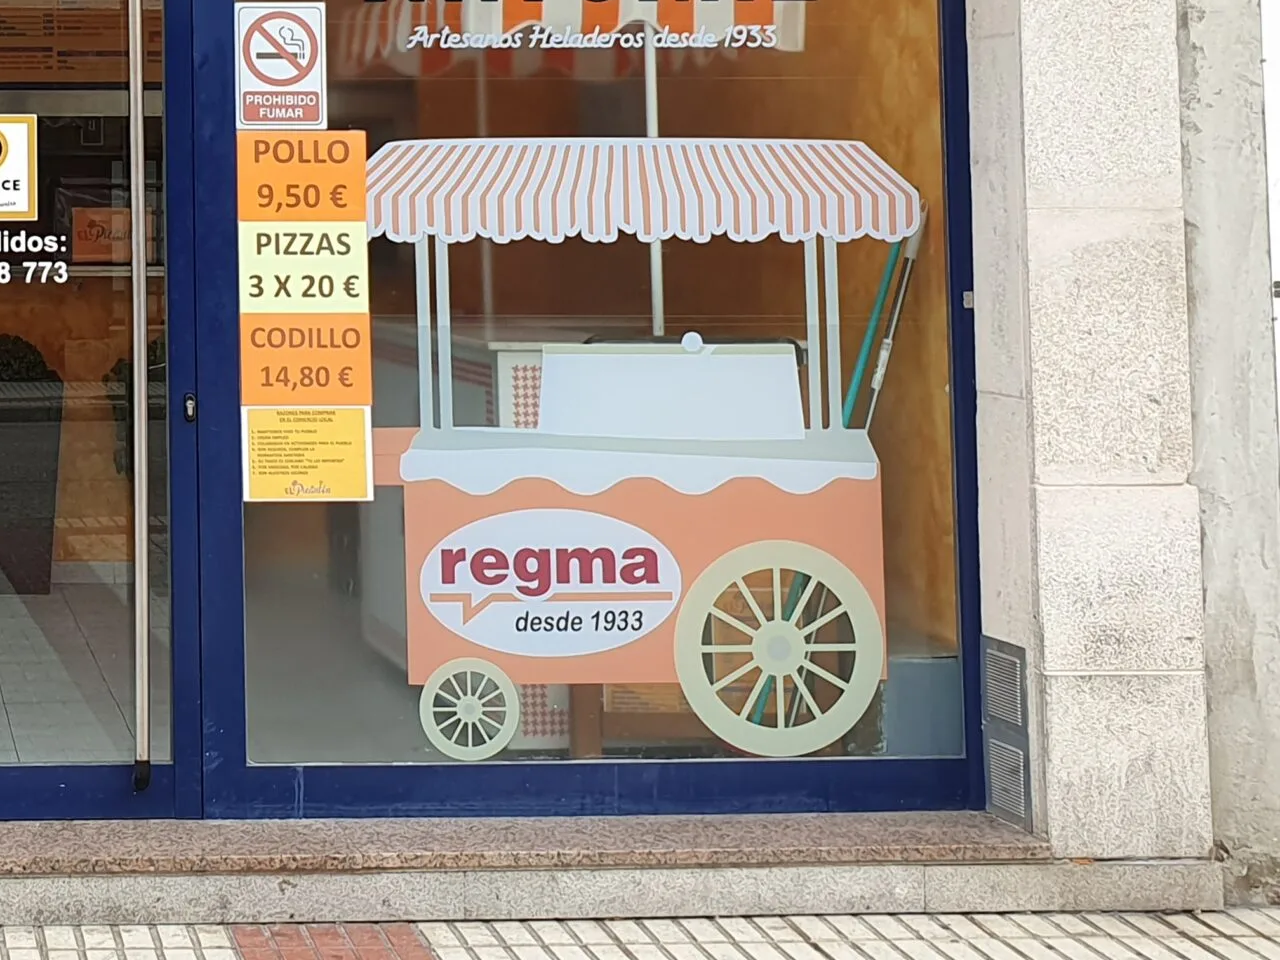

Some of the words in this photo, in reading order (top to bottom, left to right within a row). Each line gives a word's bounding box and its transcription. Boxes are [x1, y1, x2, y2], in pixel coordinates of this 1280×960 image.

[406, 25, 523, 49] Artesanos
[528, 25, 645, 49] Heladeros
[653, 25, 719, 48] desde
[724, 25, 778, 48] 1933
[246, 95, 316, 105] PROHIBIDO
[259, 108, 304, 118] FUMAR
[254, 139, 350, 164] POLLO
[257, 184, 320, 213] 9,50
[329, 184, 348, 208] €
[256, 232, 351, 256] PIZZAS
[22, 262, 68, 284] 773
[248, 274, 264, 298] 3
[273, 274, 292, 298] X
[301, 274, 334, 298] 20
[342, 274, 360, 298] €
[250, 327, 361, 349] CODILLO
[260, 366, 330, 391] 14,80
[338, 366, 353, 387] €
[440, 547, 660, 597] regma
[515, 610, 583, 632] desde
[591, 610, 644, 632] 1933
